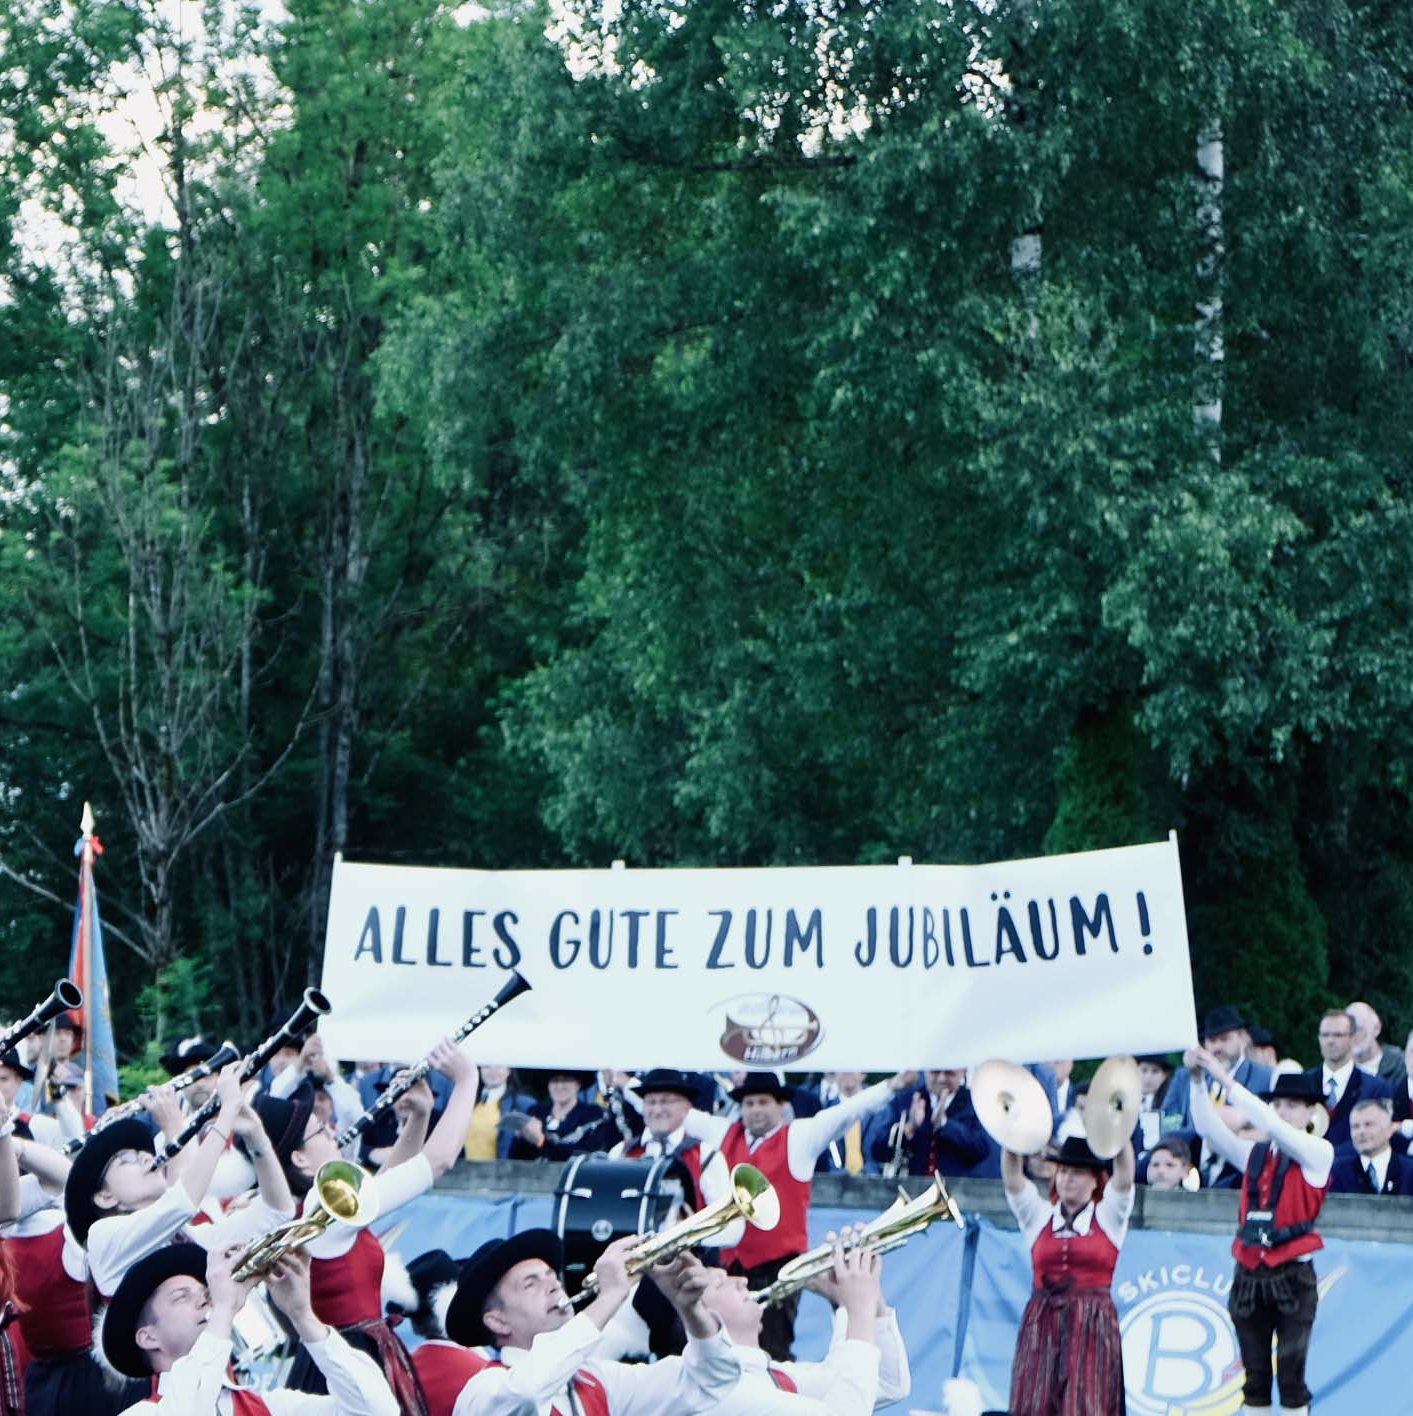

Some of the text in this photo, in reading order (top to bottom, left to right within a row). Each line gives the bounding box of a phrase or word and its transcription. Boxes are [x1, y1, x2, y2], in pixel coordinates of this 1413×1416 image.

[354, 904, 522, 970] ALLES
[548, 908, 680, 970] GUTE
[705, 907, 825, 970] ZUM
[1117, 1263, 1234, 1303] SKICLU
